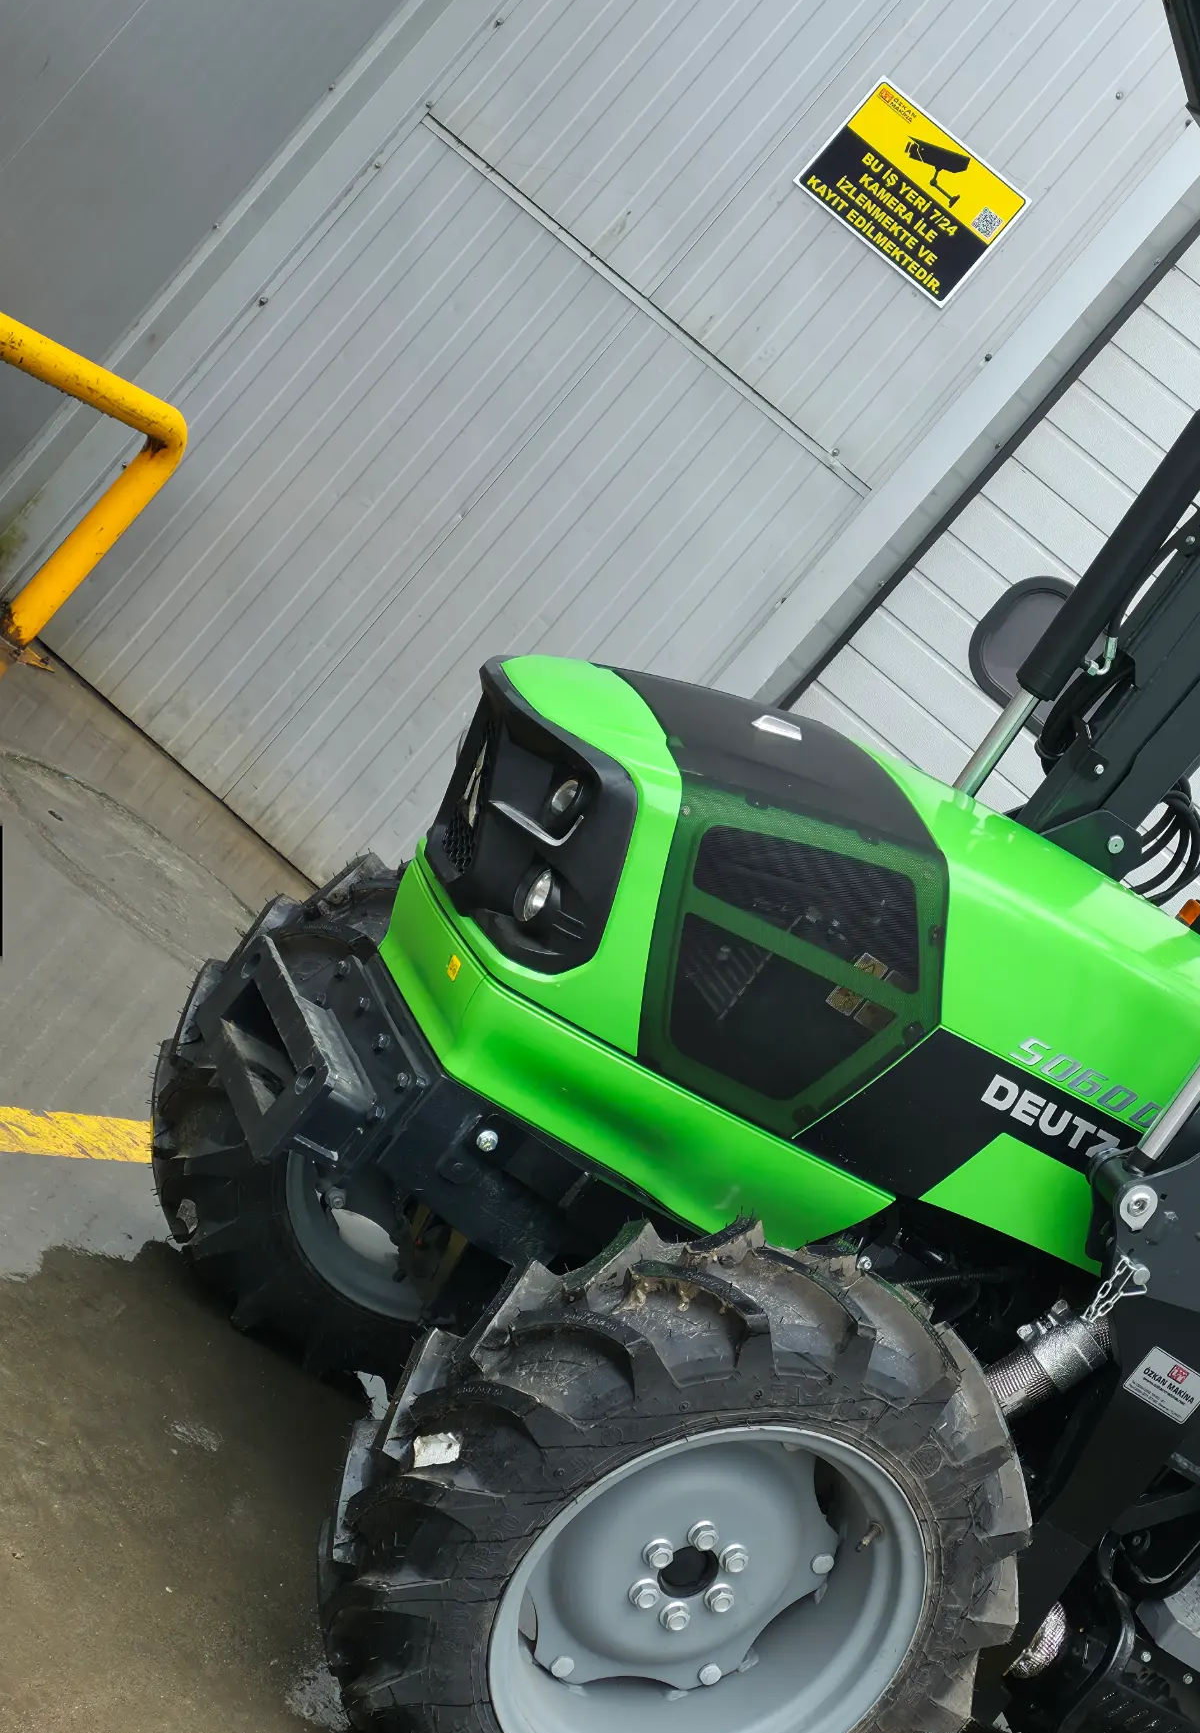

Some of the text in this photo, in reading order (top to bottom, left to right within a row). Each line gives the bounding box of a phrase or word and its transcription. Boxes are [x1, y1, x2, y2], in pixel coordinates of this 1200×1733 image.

[806, 176, 941, 295] KAYIT EDİLMEKTEDİR.
[836, 176, 938, 266] İZLENMEKTE VE
[858, 174, 938, 243] KAMERA İLE
[862, 153, 958, 237] BU İŞ YERİ 7/24
[1167, 1383, 1195, 1404] MAKİNA
